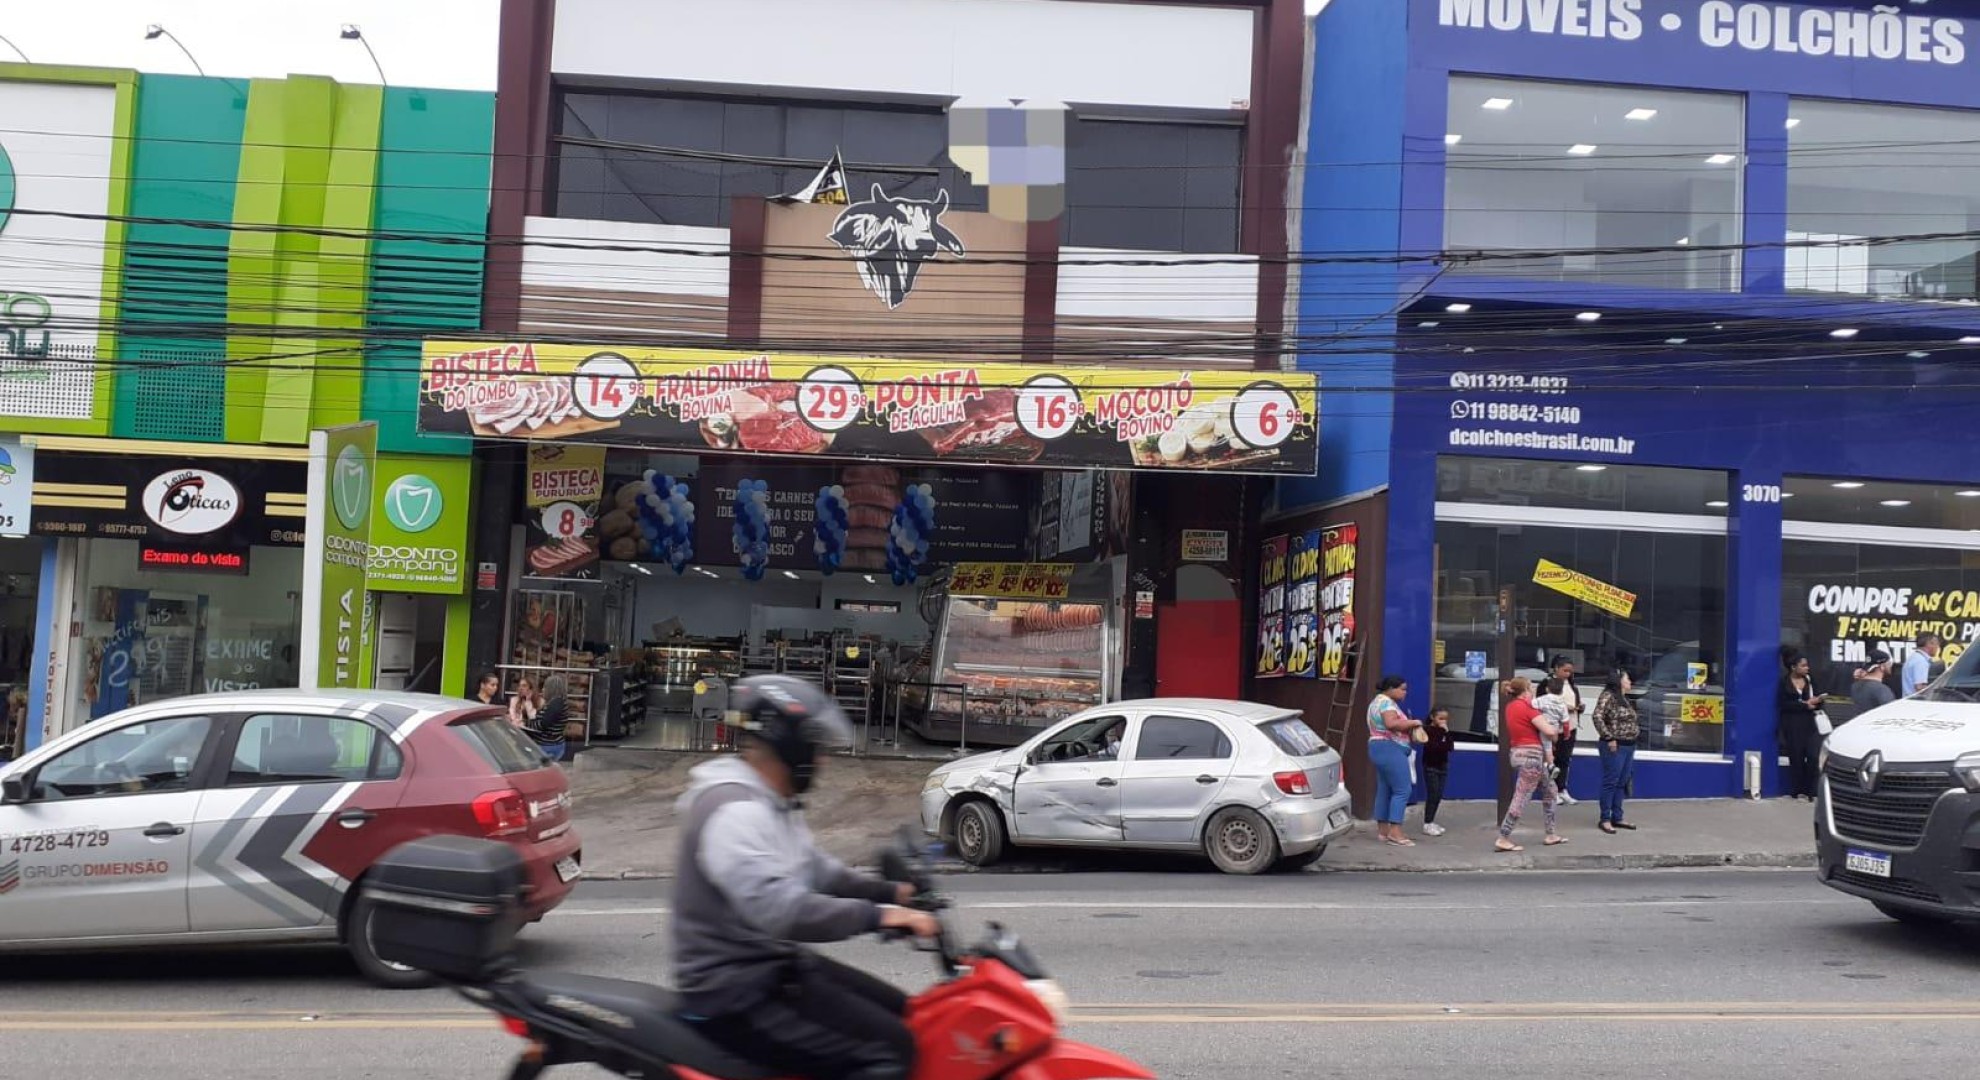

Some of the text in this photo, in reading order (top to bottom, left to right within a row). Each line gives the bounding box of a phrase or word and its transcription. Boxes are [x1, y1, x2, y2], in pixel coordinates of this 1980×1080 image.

[1701, 3, 1965, 64] COLCHÕES
[431, 343, 645, 407] BISTECA 14 98
[655, 356, 867, 419] FRALDINHA 29 98
[1470, 375, 1484, 389] 11
[444, 380, 517, 410] DO LOMBO
[682, 394, 732, 420] BOVINA
[875, 368, 1085, 429] PONTA 16 98
[1096, 373, 1303, 437] MOCOTÓ 6 98
[891, 402, 964, 430] DE AGULHA
[1118, 412, 1174, 440] BOVINO
[1470, 402, 1581, 424] 11 98842-5140
[1450, 428, 1635, 454] dcolchoesbrasil.com.br
[532, 469, 600, 490] BISTECA
[536, 488, 595, 497] PURURUCA
[1743, 484, 1780, 502] 3070
[559, 509, 575, 535] 8
[327, 535, 367, 554] ODONTO
[367, 546, 457, 561] ODONTO
[367, 557, 457, 574] company
[1808, 584, 1912, 616] COMPRE
[336, 588, 354, 688] TISTA
[1858, 618, 1957, 641] PAGAMENTO
[1831, 639, 1867, 662] EM
[10, 831, 110, 853] 4728-4729
